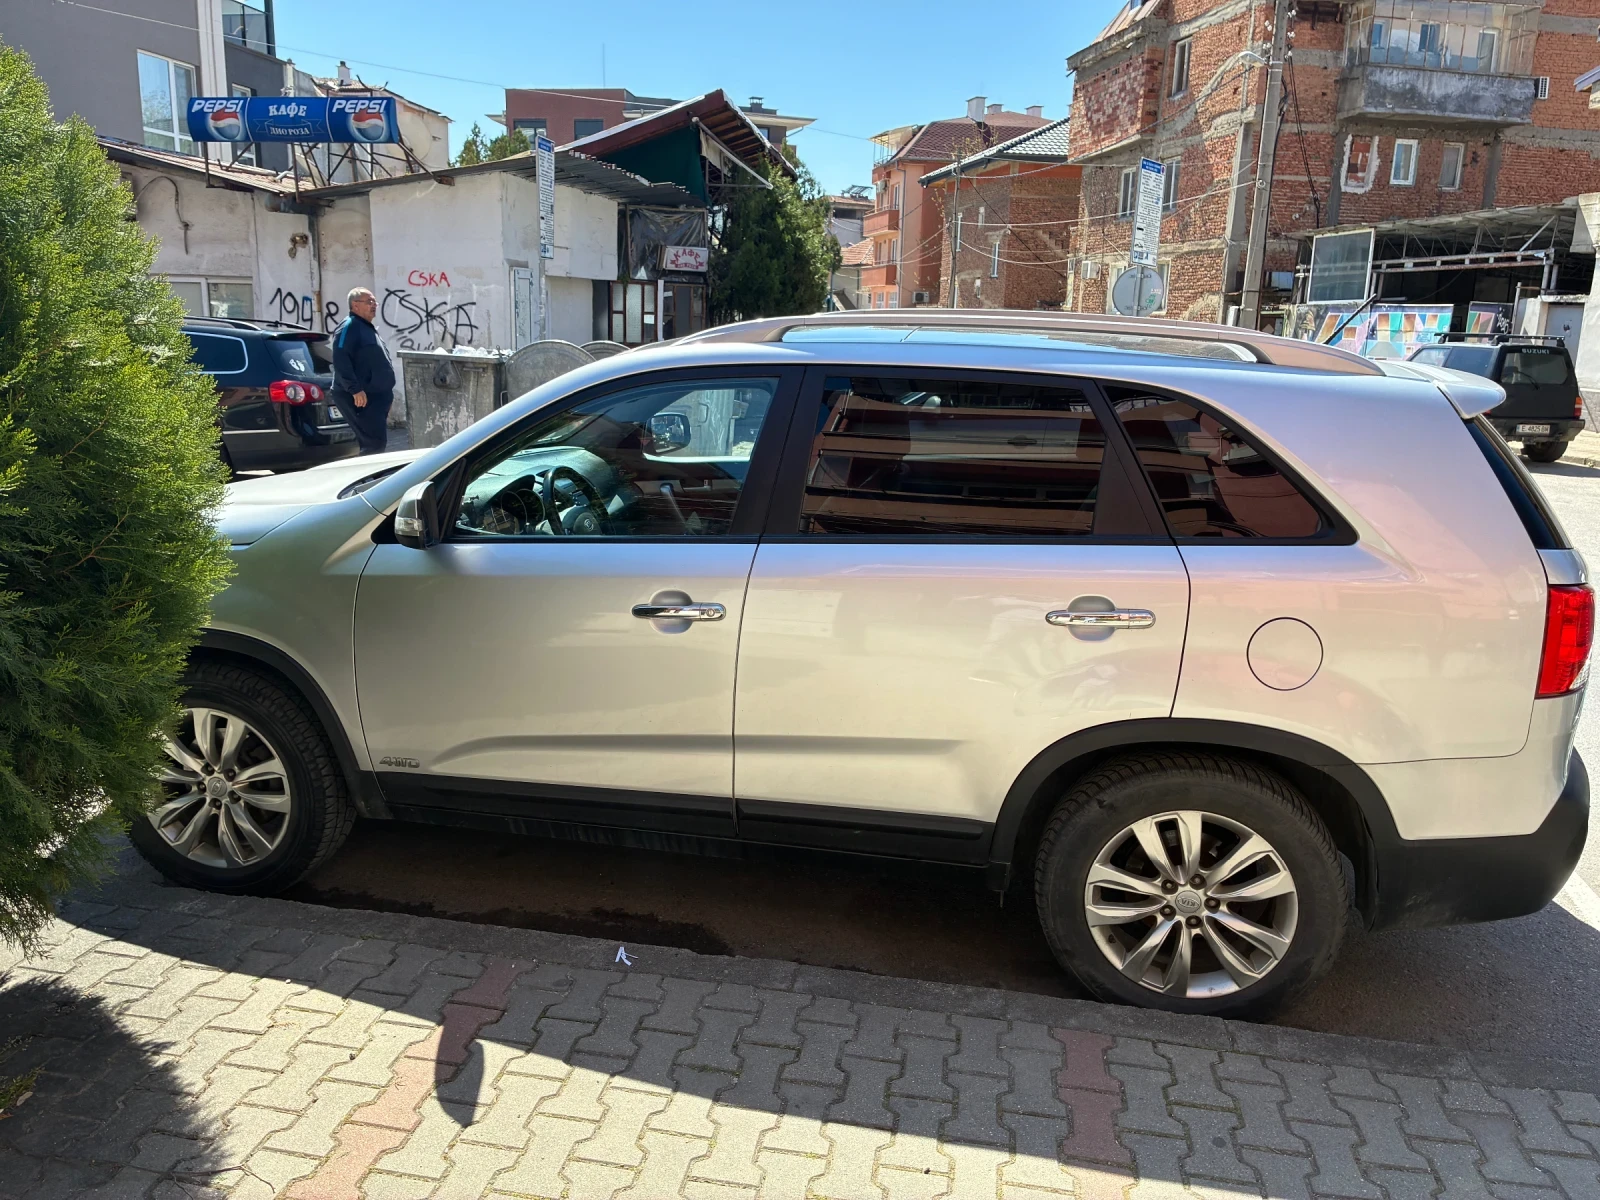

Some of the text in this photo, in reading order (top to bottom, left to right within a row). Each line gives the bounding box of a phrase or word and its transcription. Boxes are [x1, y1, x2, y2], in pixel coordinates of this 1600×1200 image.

[191, 99, 244, 113] PEPSI
[268, 103, 307, 117] КАФЕ
[332, 99, 387, 113] PEPSI
[288, 127, 310, 136] РОЗА
[673, 248, 701, 263] КАФЕ
[408, 269, 451, 287] CSKA
[381, 287, 478, 349] CSKA
